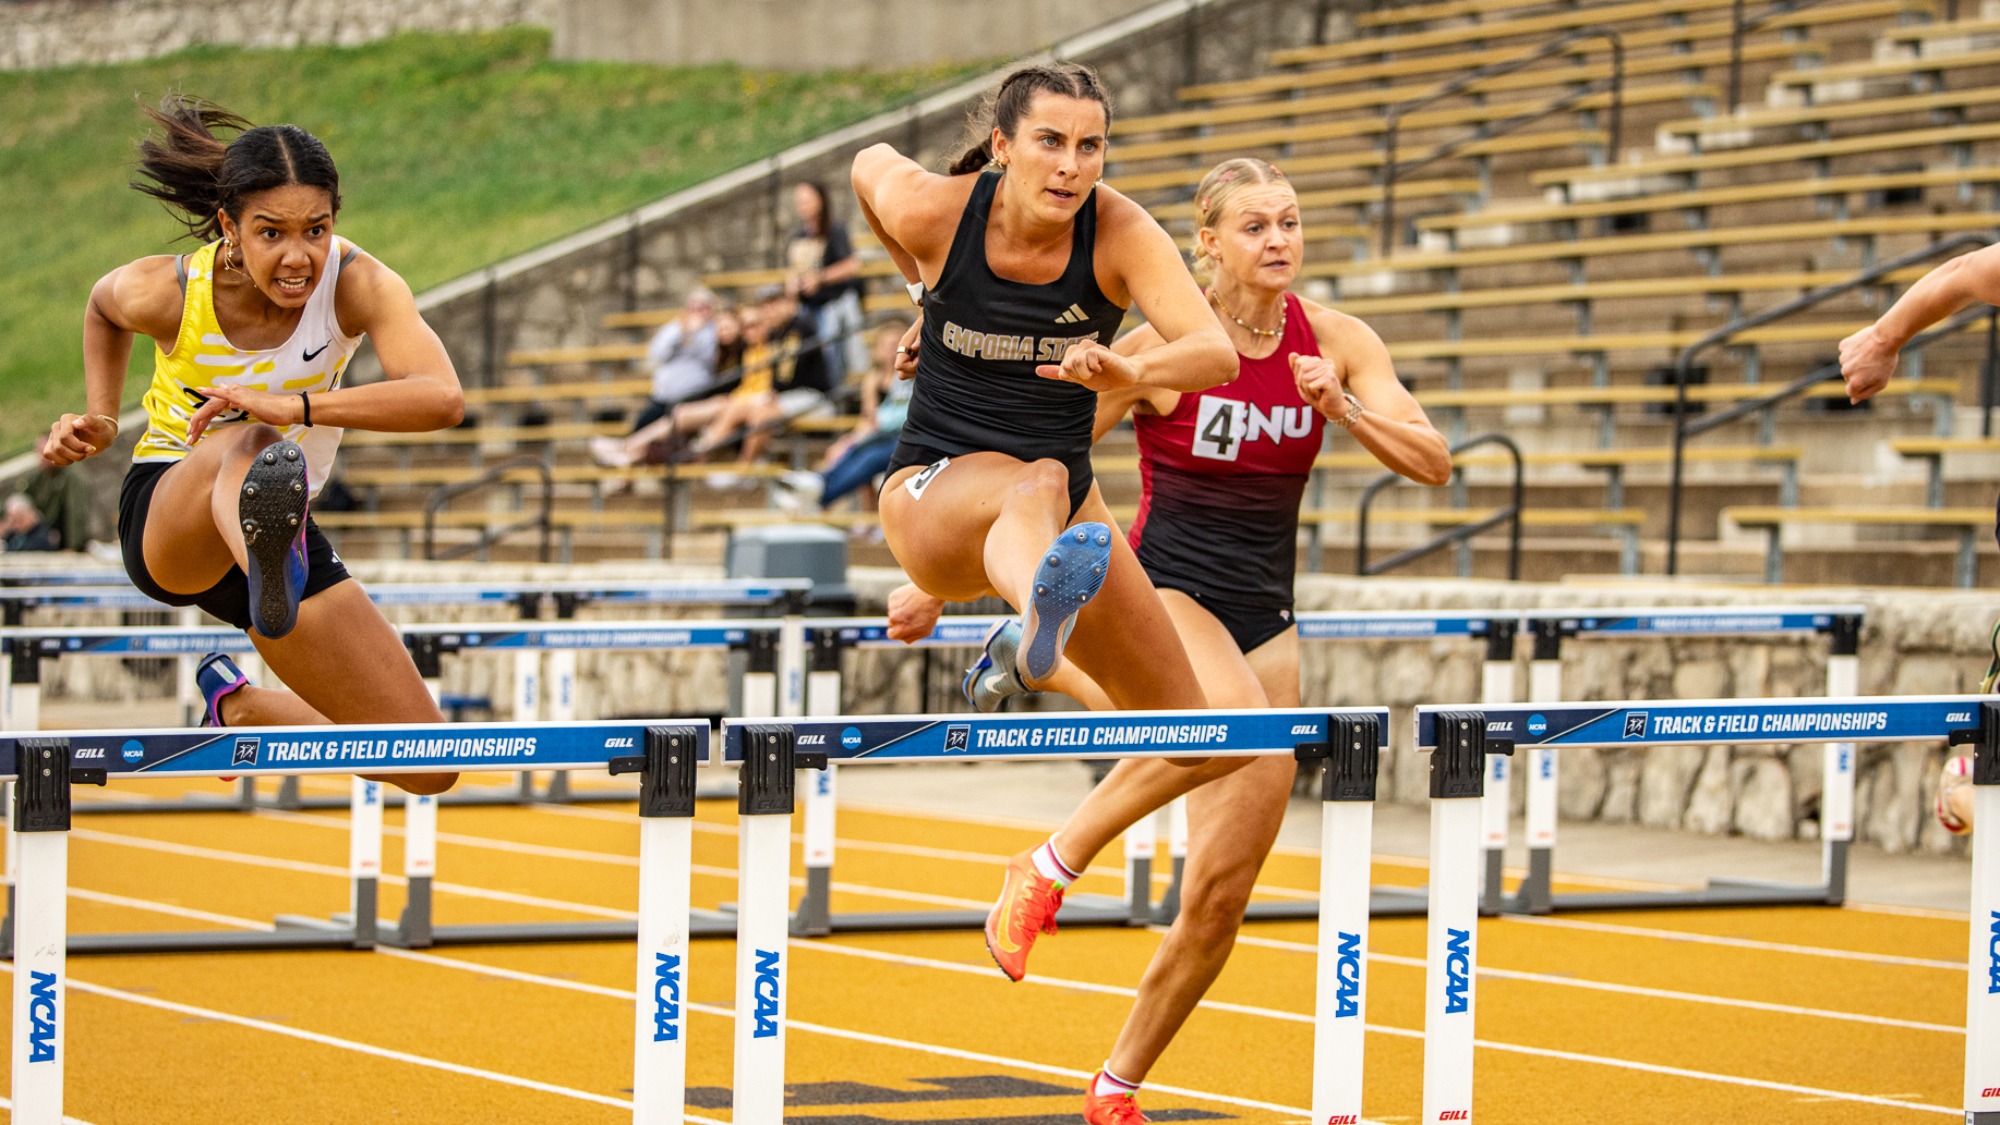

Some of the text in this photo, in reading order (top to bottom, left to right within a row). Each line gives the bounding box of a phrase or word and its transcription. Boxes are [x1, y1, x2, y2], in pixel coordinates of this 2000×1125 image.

[943, 321, 1099, 361] EMPORIA STA
[1201, 403, 1235, 455] 4
[1653, 711, 1888, 735] TRACK & FIELD CHAMPIONSHIPS
[1945, 712, 1972, 723] GILL
[1290, 725, 1318, 735] GILL
[1486, 721, 1514, 732] GILL
[1528, 723, 1547, 731] NCAA
[797, 735, 826, 745] GILL
[842, 736, 862, 744] NCAA
[976, 724, 1229, 748] TRACK & FIELD CHAMPIONSHIPS
[604, 737, 633, 748] GILL
[75, 748, 105, 759] GILL
[123, 750, 144, 758] NCAA
[267, 737, 538, 761] TRACK & FIELD CHAMPIONSHIPS
[1335, 931, 1361, 1019] NCAA
[1445, 927, 1471, 1014] NCAA
[653, 952, 681, 1042] NCAA
[754, 949, 780, 1040] NCAA
[29, 970, 57, 1063] NCAA
[1981, 1087, 2000, 1098] GIL
[1327, 1114, 1357, 1125] GILL
[1439, 1110, 1468, 1121] GILL
